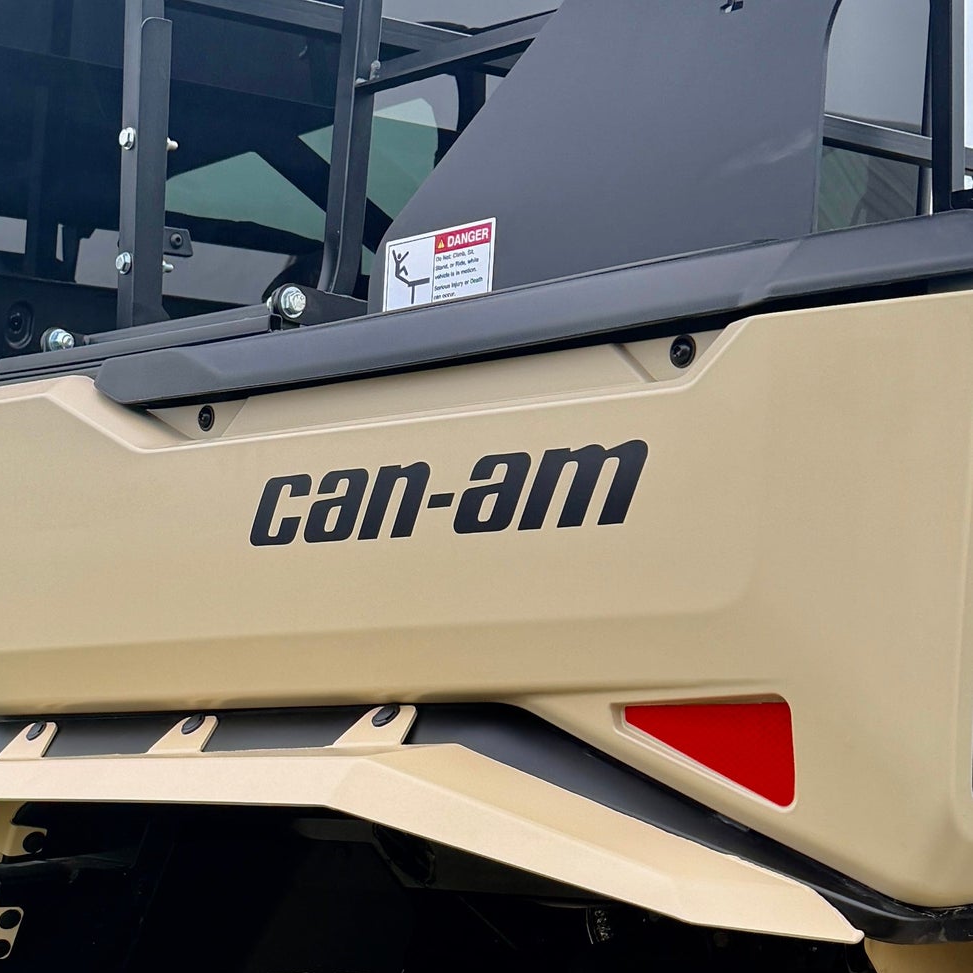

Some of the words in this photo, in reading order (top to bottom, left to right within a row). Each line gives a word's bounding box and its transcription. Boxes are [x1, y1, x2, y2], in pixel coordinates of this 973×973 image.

[448, 228, 488, 247] DANGER
[470, 276, 483, 284] Death
[249, 439, 648, 546] can-am
